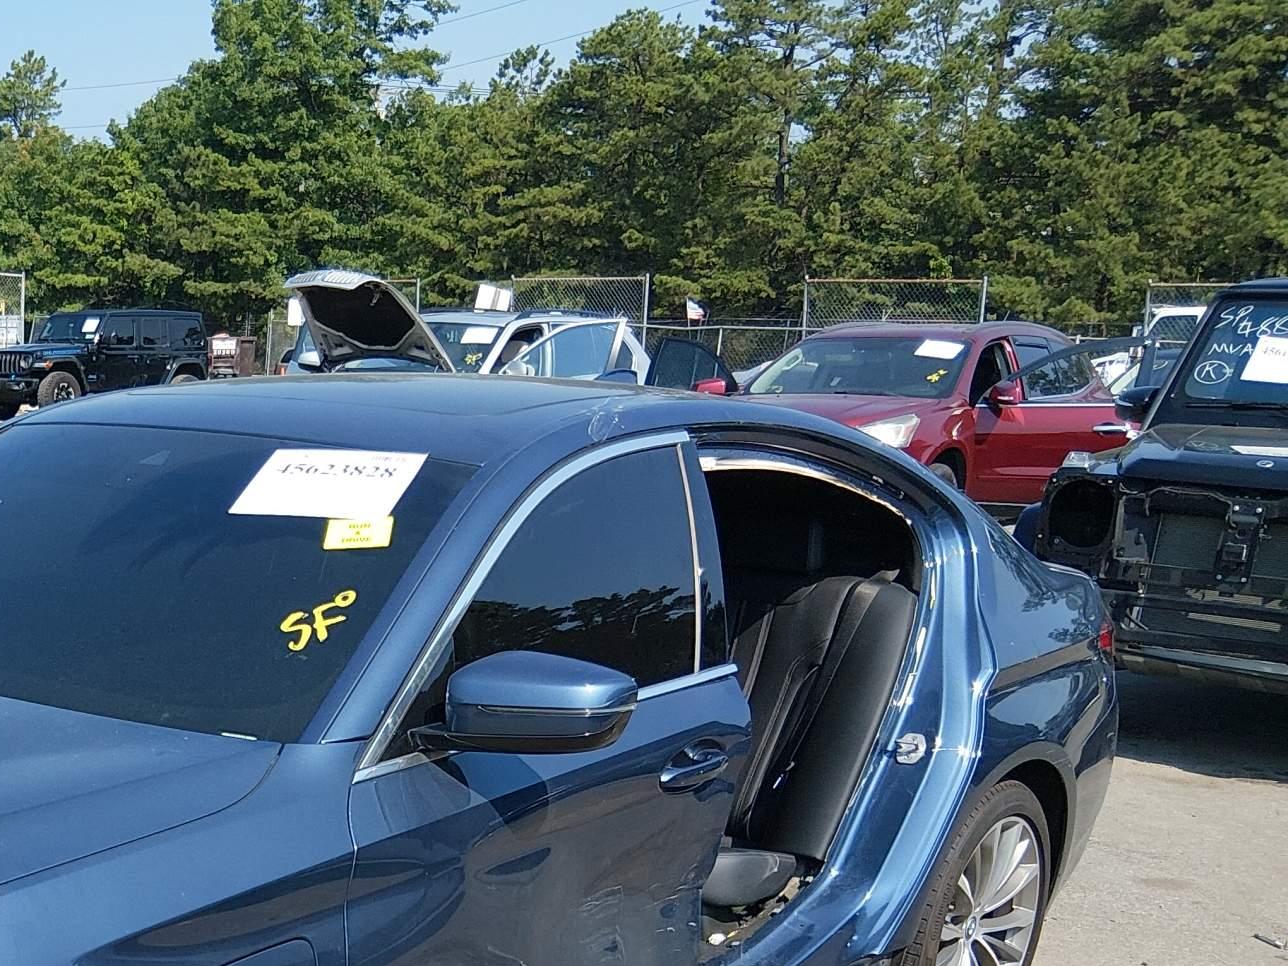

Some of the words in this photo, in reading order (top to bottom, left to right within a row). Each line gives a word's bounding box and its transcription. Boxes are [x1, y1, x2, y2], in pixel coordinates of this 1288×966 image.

[1207, 342, 1254, 357] MVA
[1200, 363, 1219, 380] K
[276, 463, 398, 479] 45623828
